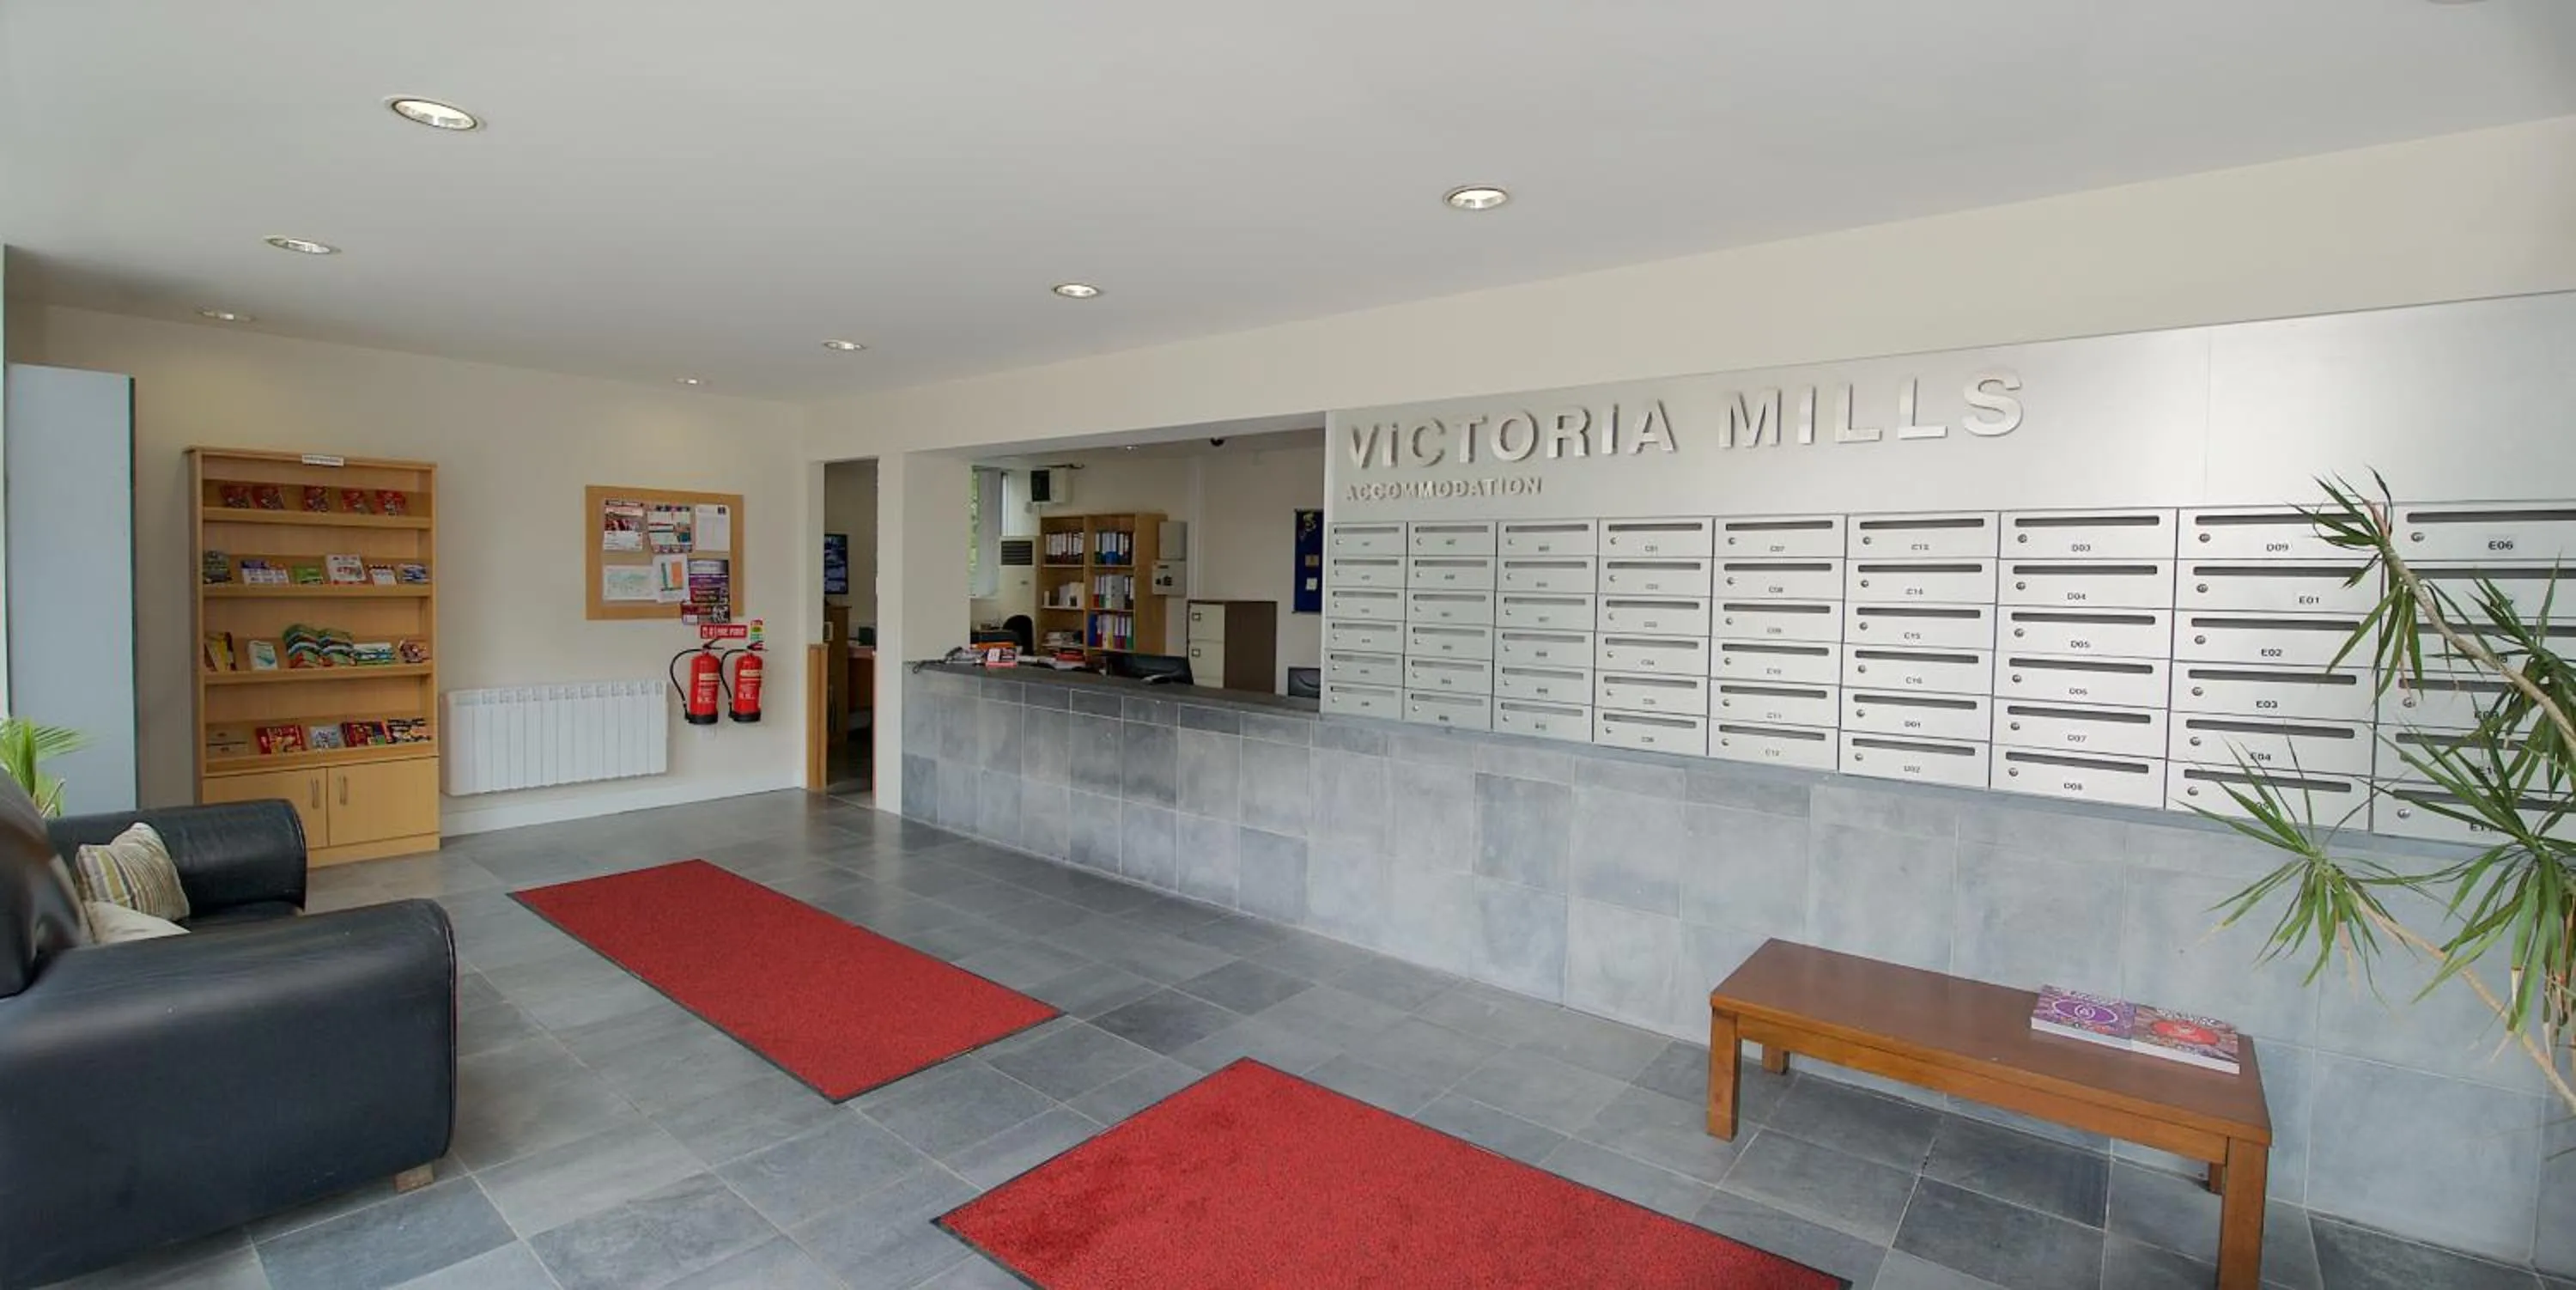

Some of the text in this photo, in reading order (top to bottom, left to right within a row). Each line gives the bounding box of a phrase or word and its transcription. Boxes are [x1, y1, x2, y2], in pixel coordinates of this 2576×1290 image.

[1349, 368, 2023, 469] VICTORIA MILLS
[1346, 475, 1542, 502] ACCOMMODATION
[2070, 543, 2092, 552] D03
[2266, 543, 2290, 552] D09
[2488, 540, 2514, 551] E06
[2067, 592, 2087, 601] D04
[2299, 595, 2319, 605] E01
[2070, 640, 2091, 648] D05
[2260, 648, 2283, 657] E02
[2069, 687, 2088, 696] D06
[2256, 700, 2278, 709] E03
[2067, 734, 2087, 743] D07
[2250, 751, 2272, 762] E04
[2063, 782, 2083, 791] D08
